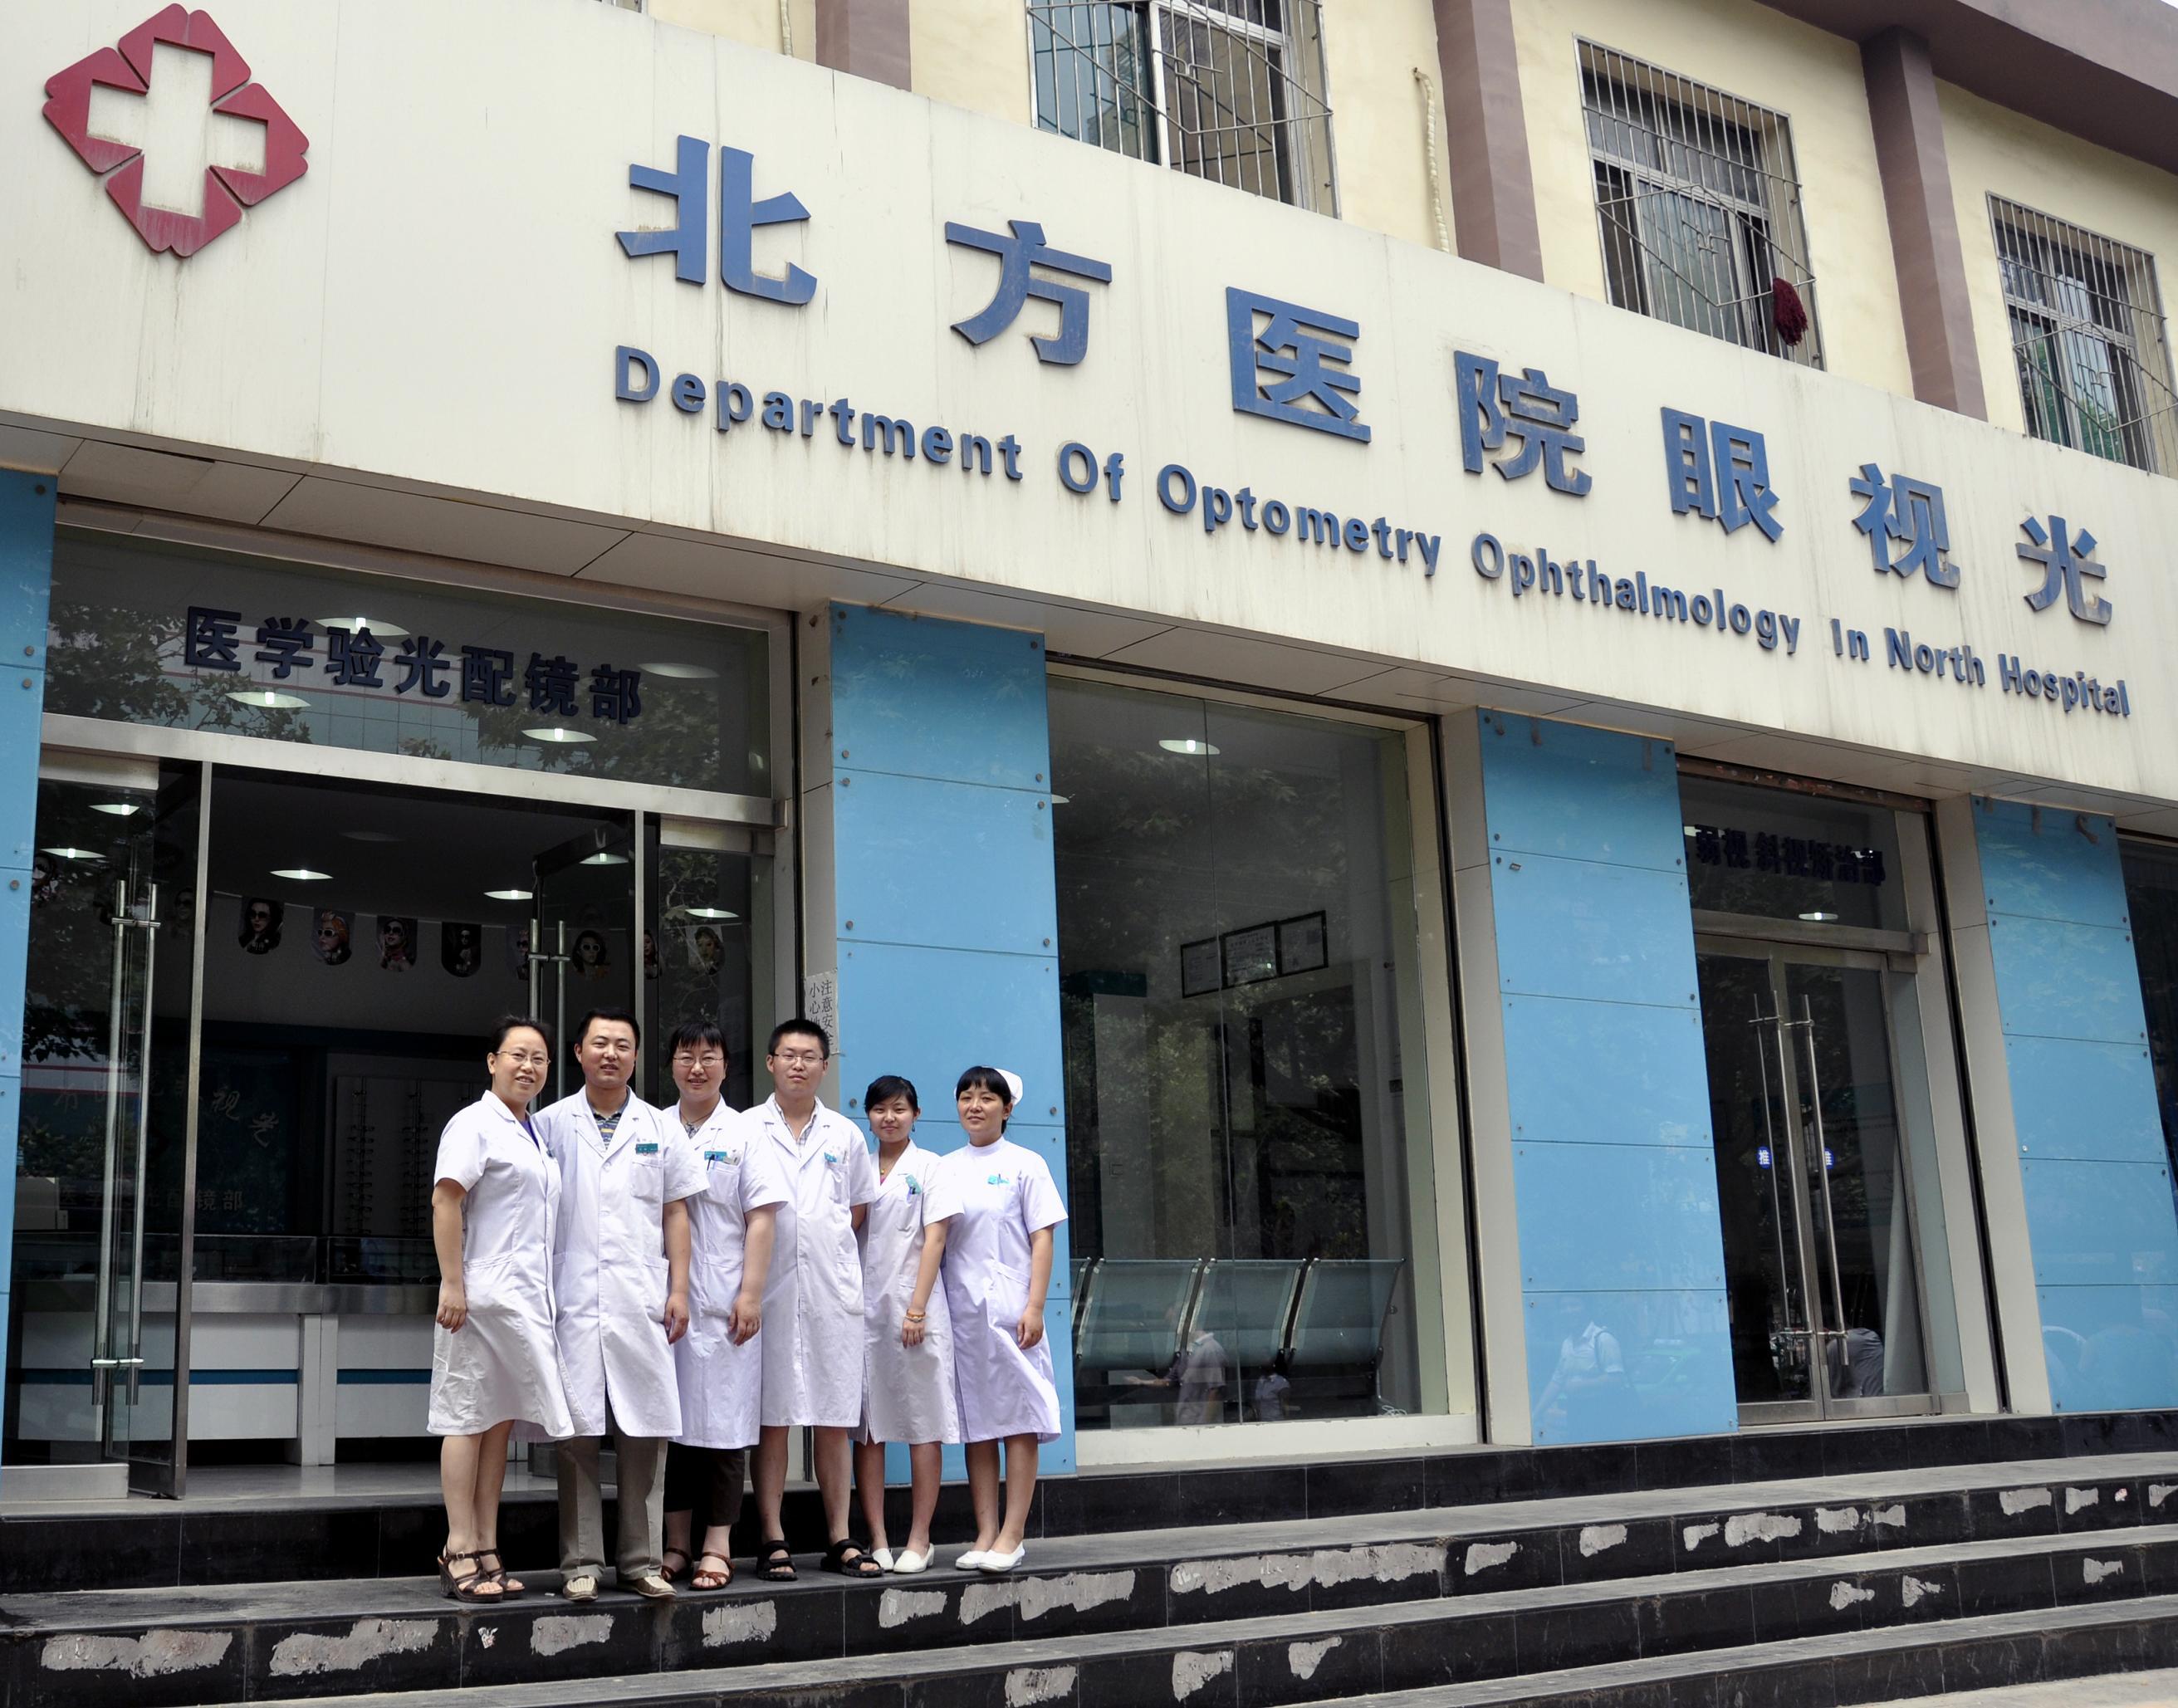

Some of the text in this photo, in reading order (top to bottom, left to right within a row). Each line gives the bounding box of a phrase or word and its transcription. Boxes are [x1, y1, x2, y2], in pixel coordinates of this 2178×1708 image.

[615, 135, 2112, 626] 北方医院眼视光
[615, 345, 2131, 717] Department Of Optometry Ophthalmology In North Hospital
[185, 605, 643, 726] 医学验光配镜部
